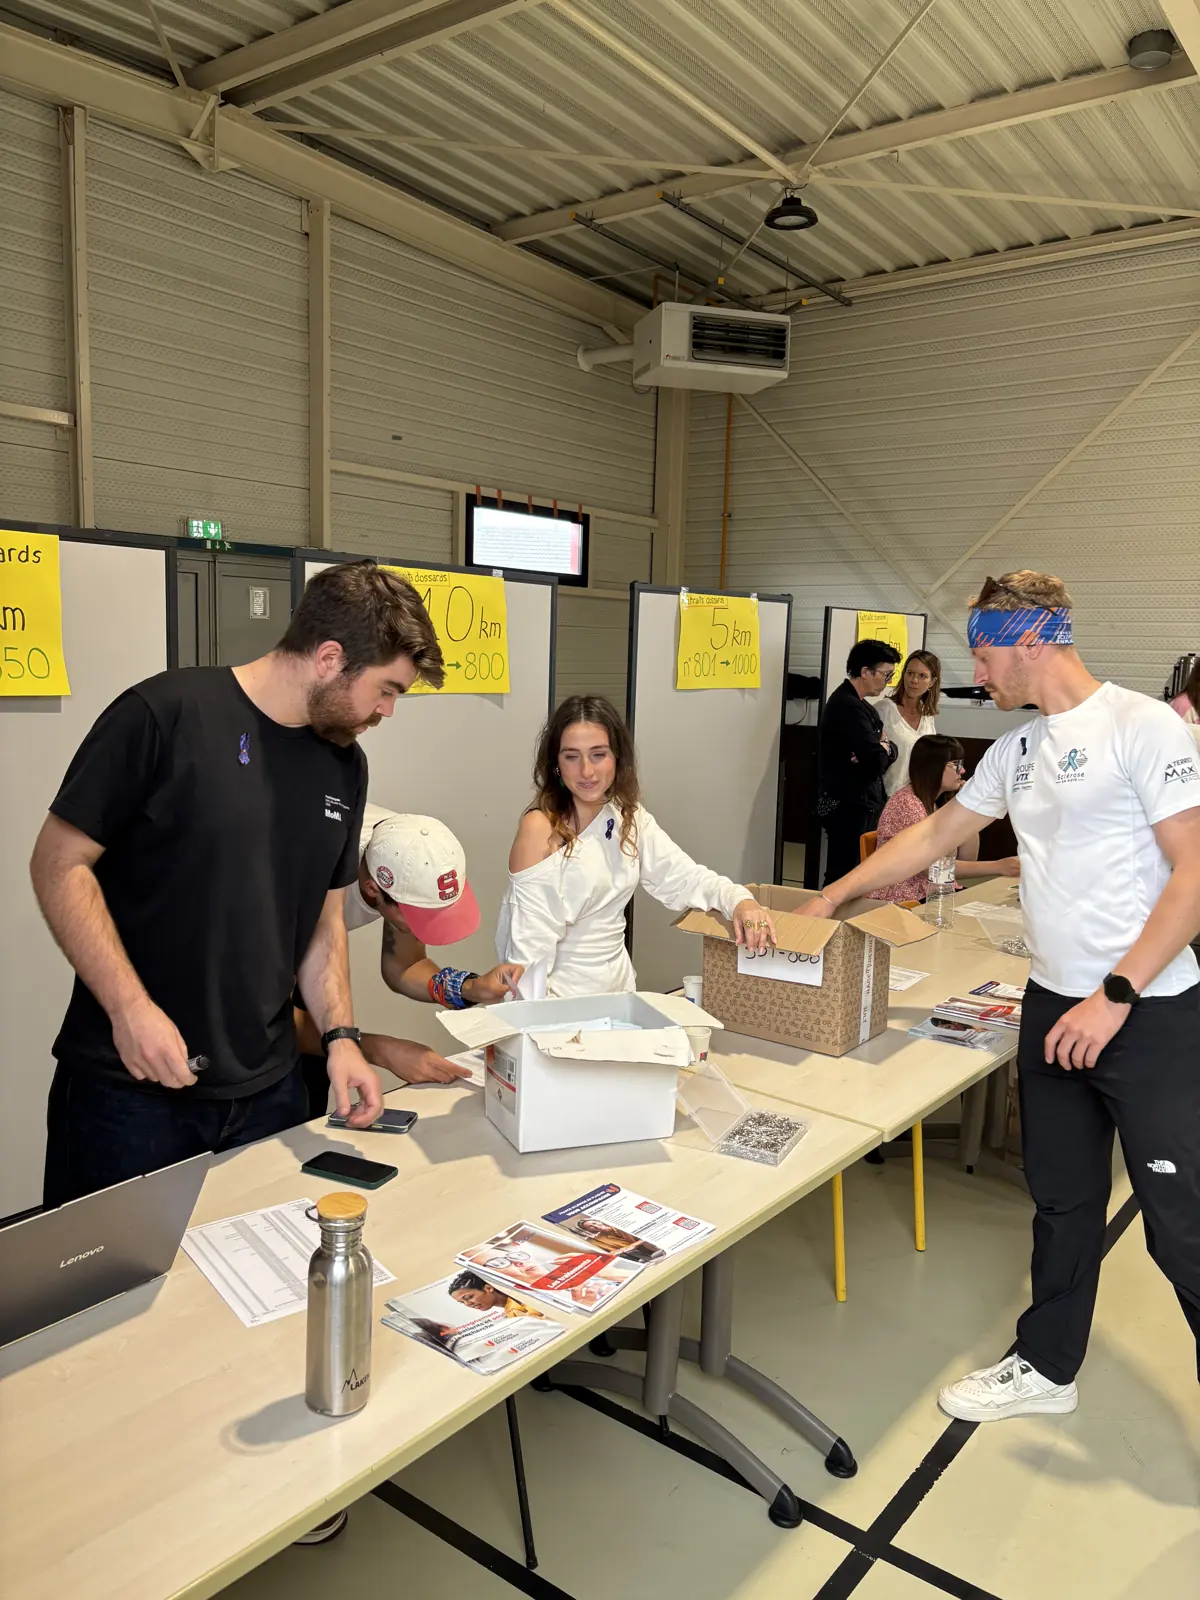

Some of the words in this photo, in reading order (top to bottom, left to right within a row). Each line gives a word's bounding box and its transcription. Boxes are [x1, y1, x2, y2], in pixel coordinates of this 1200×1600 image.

[0, 606, 26, 631] m
[479, 606, 502, 639] km
[710, 607, 729, 650] 5
[731, 620, 752, 647] km
[0, 646, 51, 679] 50
[464, 652, 505, 681] 800
[732, 653, 758, 675] 1000
[1015, 762, 1036, 774] ROUPE
[1016, 773, 1030, 782] VTX
[59, 1245, 105, 1269] Lenovo
